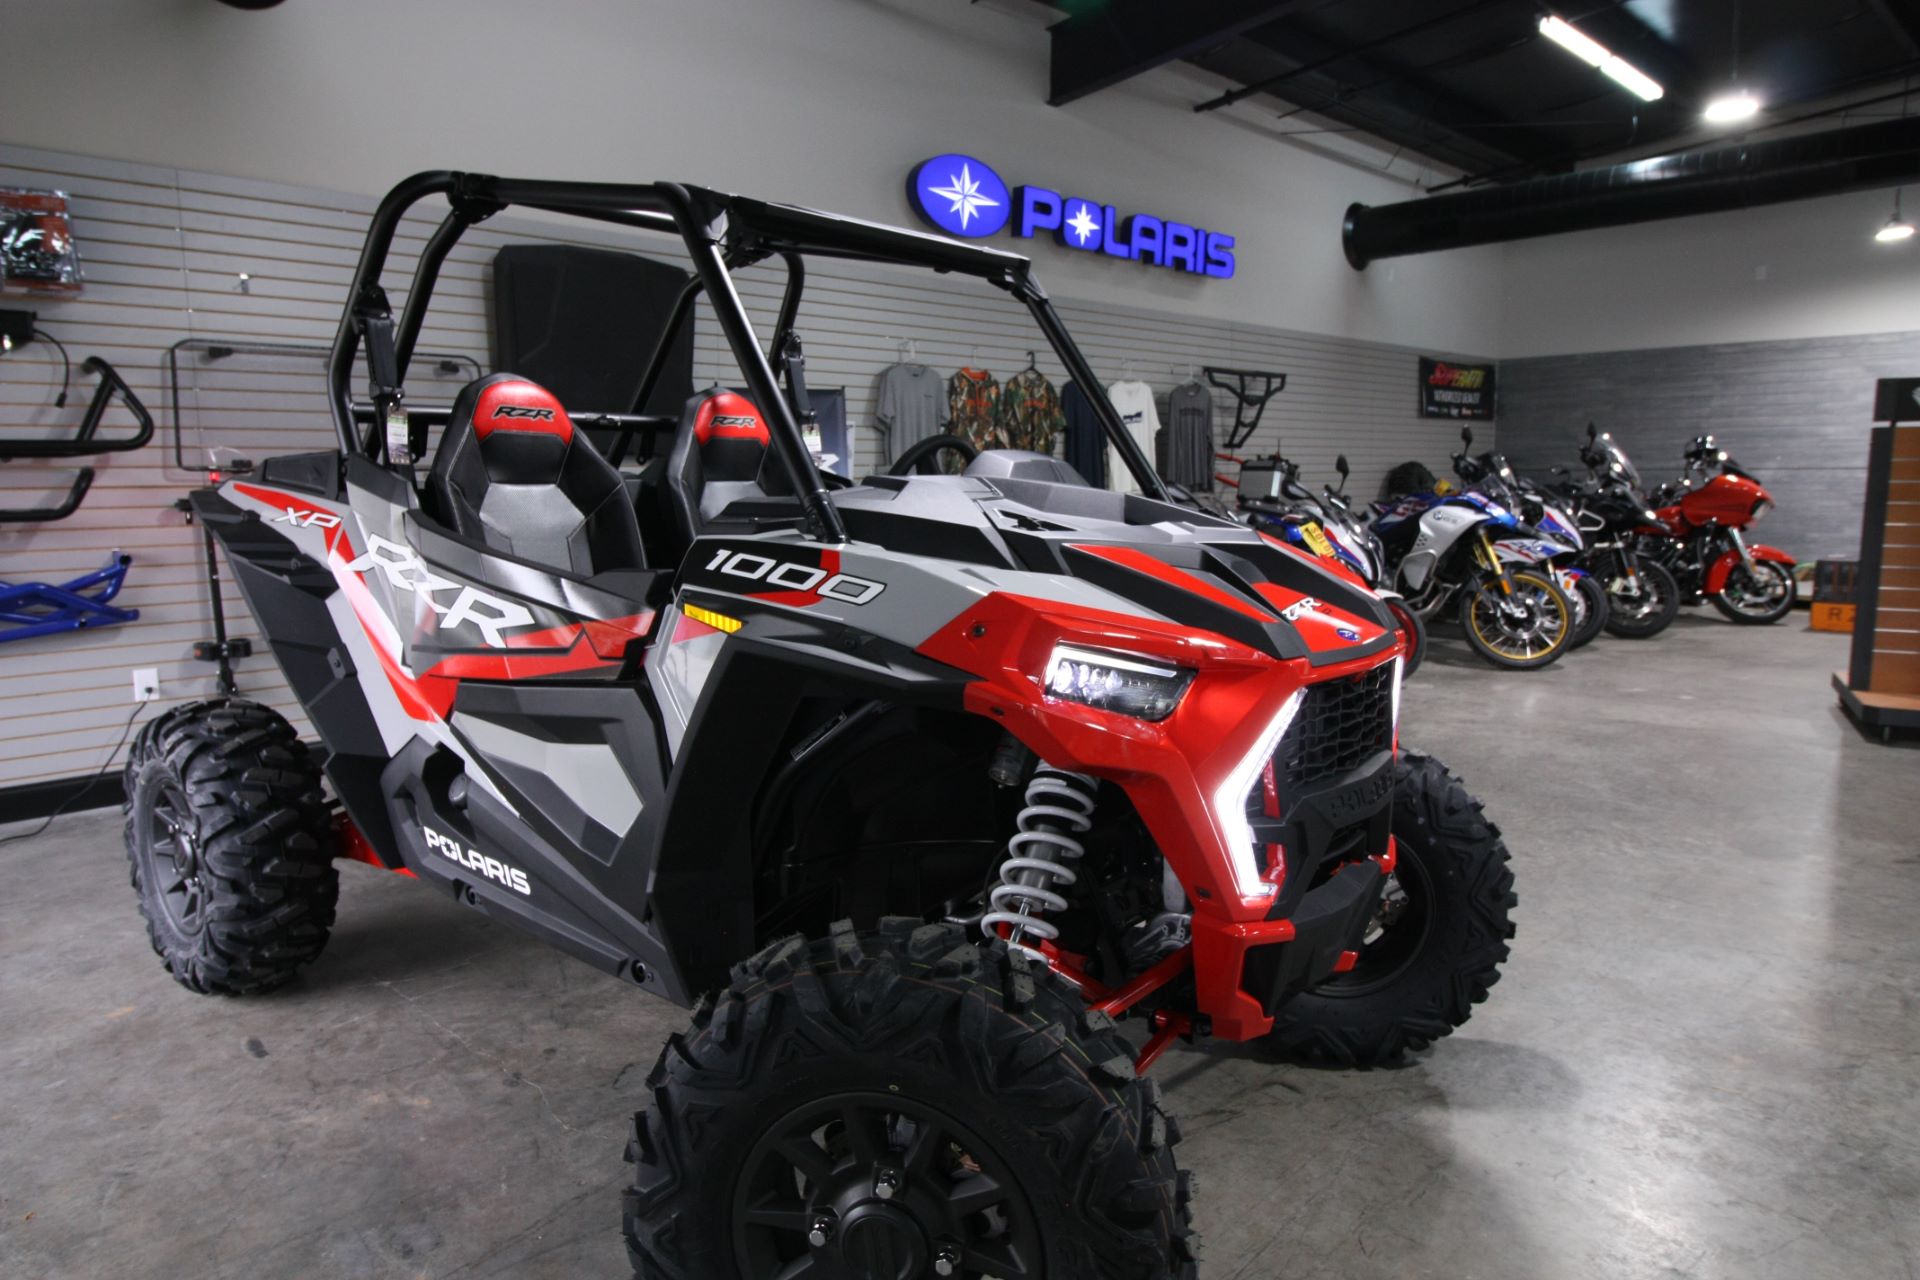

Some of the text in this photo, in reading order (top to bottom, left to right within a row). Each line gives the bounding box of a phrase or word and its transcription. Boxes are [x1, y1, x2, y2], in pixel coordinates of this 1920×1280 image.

[1014, 184, 1236, 279] POLARIS
[491, 405, 555, 421] RZR
[709, 415, 757, 429] RZR
[272, 507, 343, 528] XP
[343, 533, 535, 648] RZR
[705, 549, 887, 605] 1000
[423, 825, 531, 893] POLARIS
